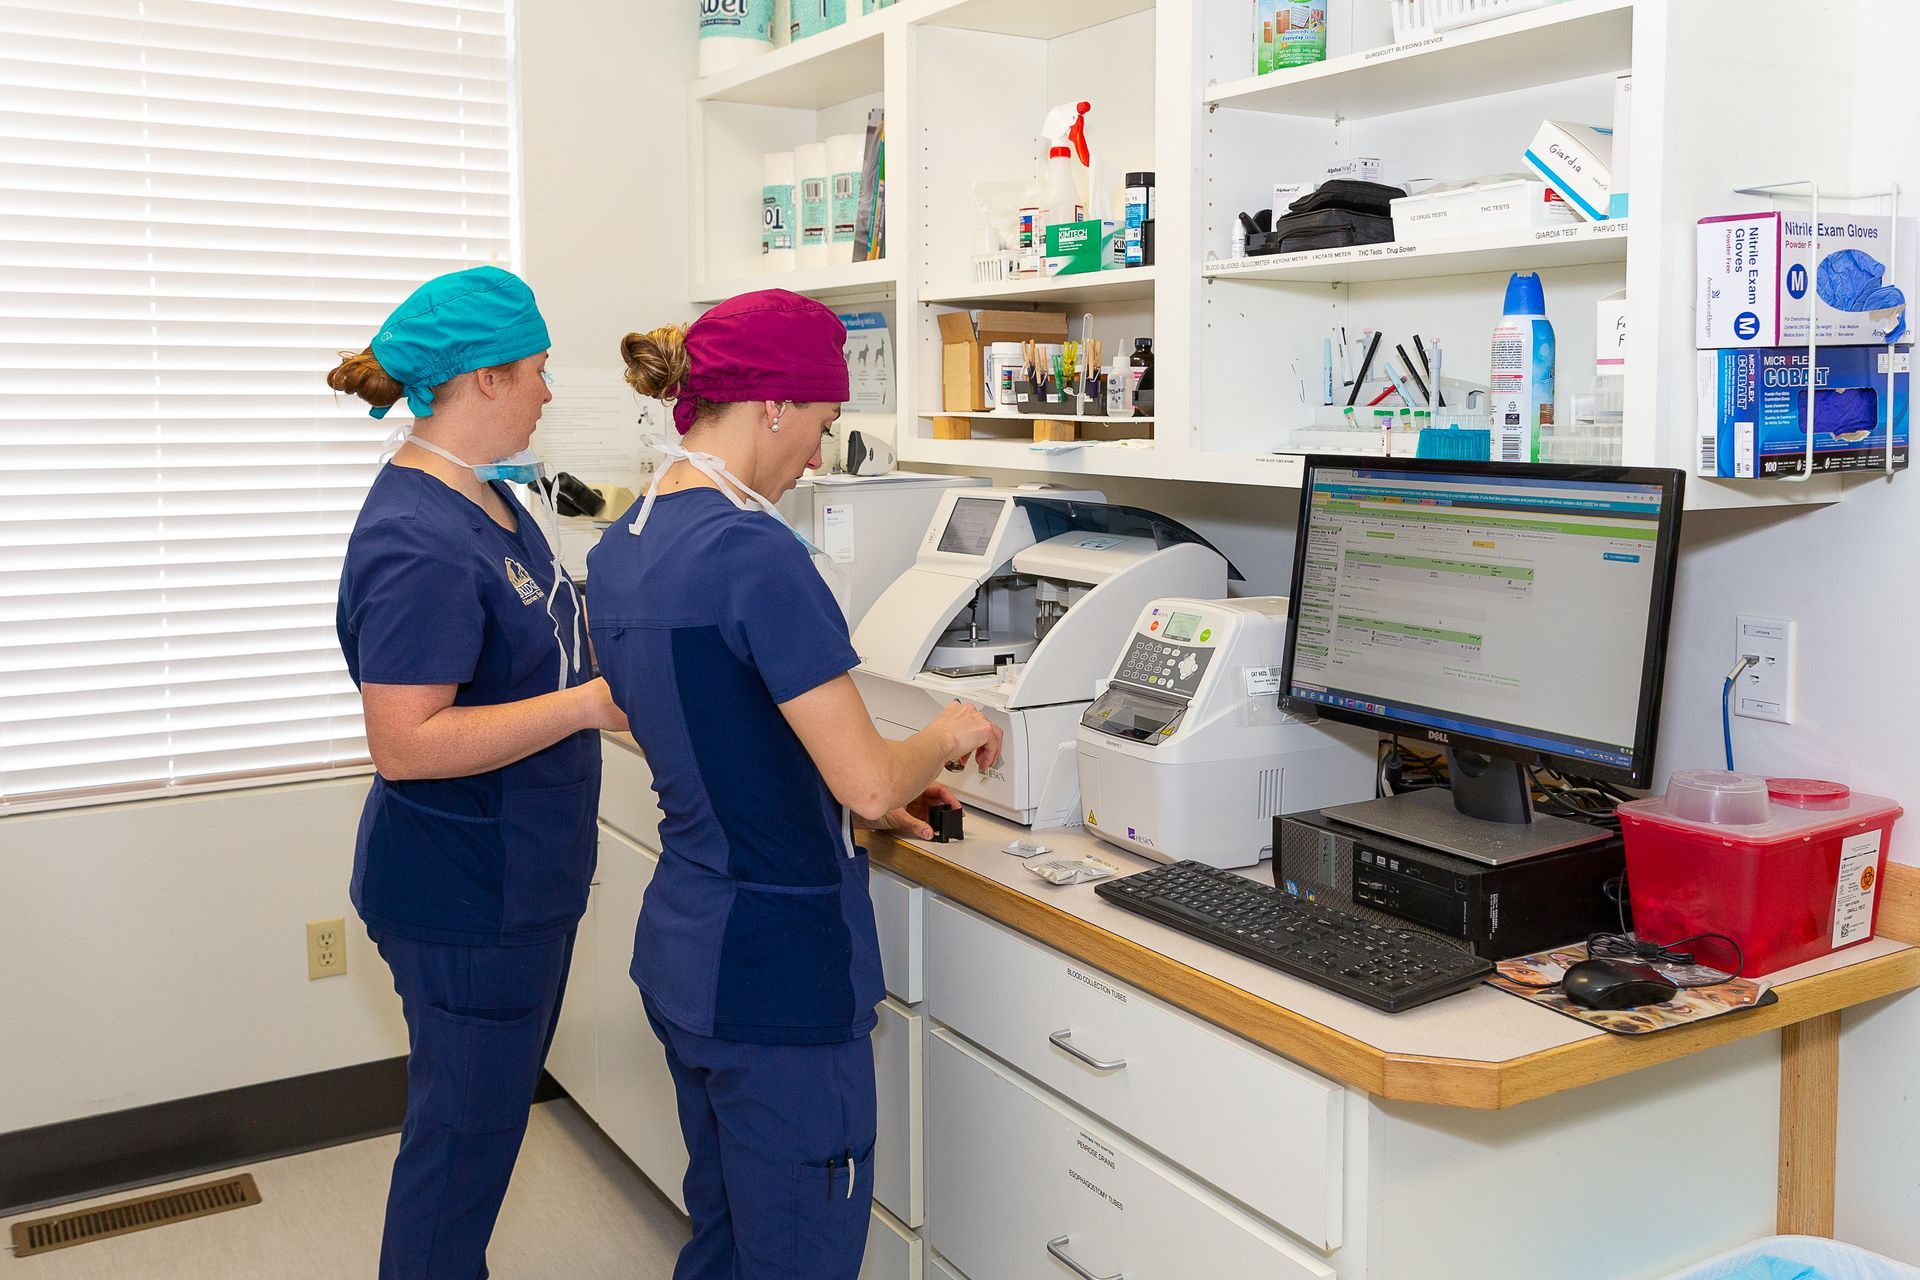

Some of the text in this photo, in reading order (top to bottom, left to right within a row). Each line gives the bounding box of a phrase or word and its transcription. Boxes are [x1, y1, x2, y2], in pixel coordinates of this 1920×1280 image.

[1365, 36, 1444, 59] SURGICUTT BLEEDING DEVICE
[1549, 144, 1582, 174] Giardia
[1059, 229, 1088, 239] KIMTECH
[1536, 228, 1578, 240] GIARDIA TEST
[1593, 224, 1616, 233] PARVO
[1785, 222, 1878, 239] Nitrile Exam Gloves
[1735, 228, 1745, 273] Gloves
[1785, 240, 1807, 250] Powder
[1749, 227, 1759, 305] Nitrile Exam
[1791, 271, 1804, 292] M
[1739, 317, 1755, 335] M
[1737, 354, 1748, 410] COBALT
[1765, 462, 1777, 472] 100
[1428, 730, 1449, 743] DELL
[1068, 968, 1127, 1003] BLOOD COLLECTION TUBES
[1077, 1140, 1115, 1170] PENROSE DRAINS
[1069, 1169, 1124, 1211] ESOPHAGOSTOMY TUBES
